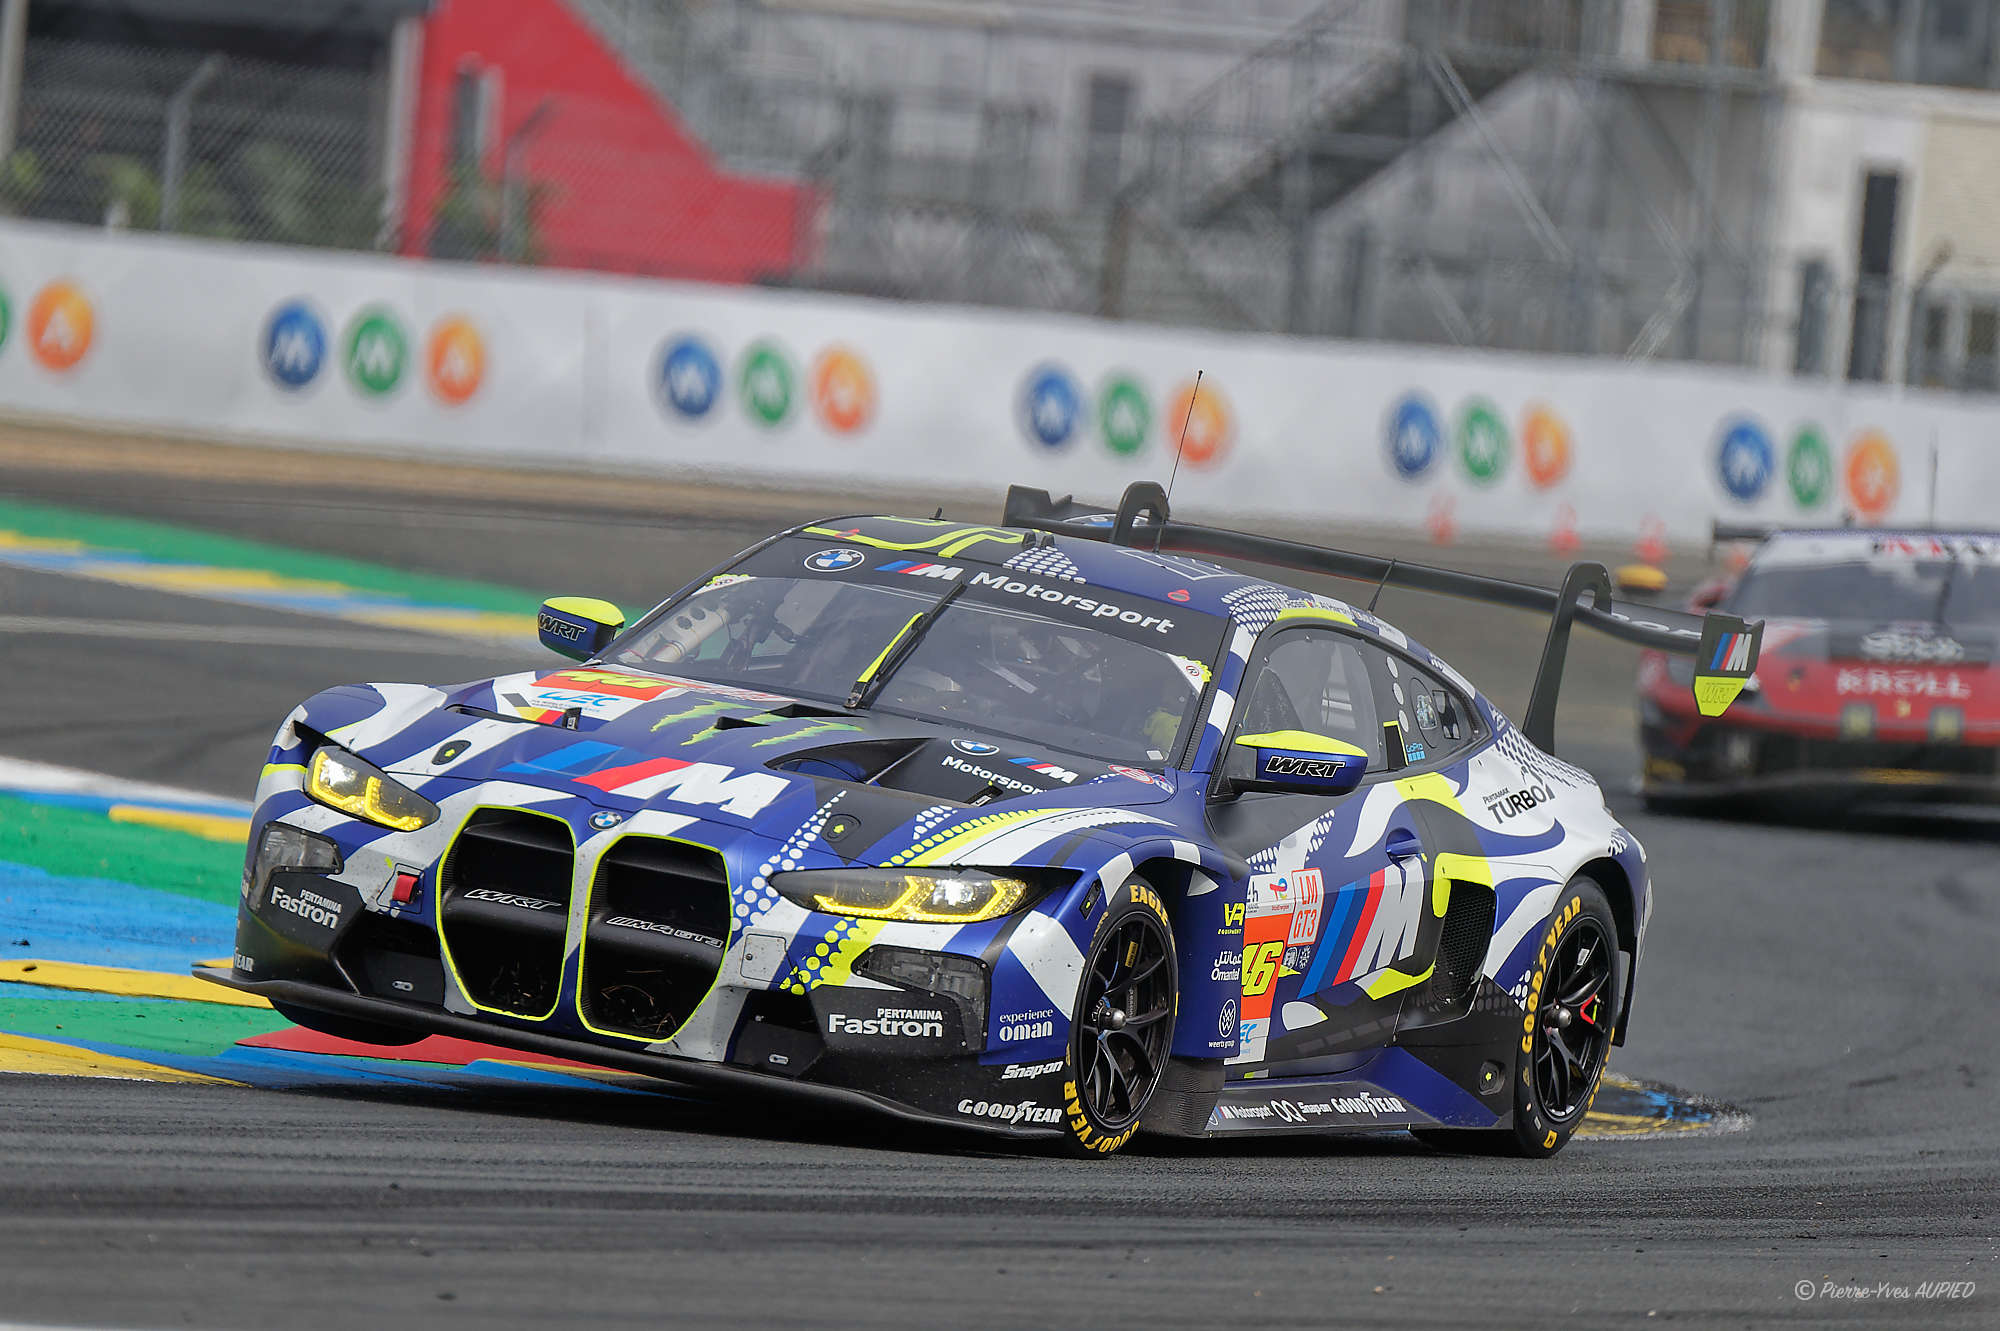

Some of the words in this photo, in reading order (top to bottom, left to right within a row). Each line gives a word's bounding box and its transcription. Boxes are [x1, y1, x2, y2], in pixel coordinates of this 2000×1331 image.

[970, 571, 1176, 635] Motorsport
[538, 612, 588, 642] WRT
[941, 756, 1048, 795] Motorspor
[1265, 756, 1346, 778] WRT
[1488, 784, 1547, 825] TURBO
[300, 888, 342, 914] PERTAMINA
[464, 889, 562, 910] WRT
[1299, 875, 1318, 905] LM
[270, 886, 339, 929] Fastron
[1293, 908, 1317, 939] GT3
[1211, 968, 1241, 981] Omantel
[1242, 940, 1285, 997] 46
[1522, 895, 1581, 1053] GOODYEAR
[828, 1013, 944, 1038] Fastron
[877, 1007, 944, 1021] PERTAMINA
[999, 1008, 1054, 1024] experience
[999, 1020, 1053, 1042] oman
[958, 1099, 1063, 1125] GOODYEAR
[1232, 1104, 1274, 1120] Motorsport
[1331, 1091, 1407, 1119] GOODYEAR
